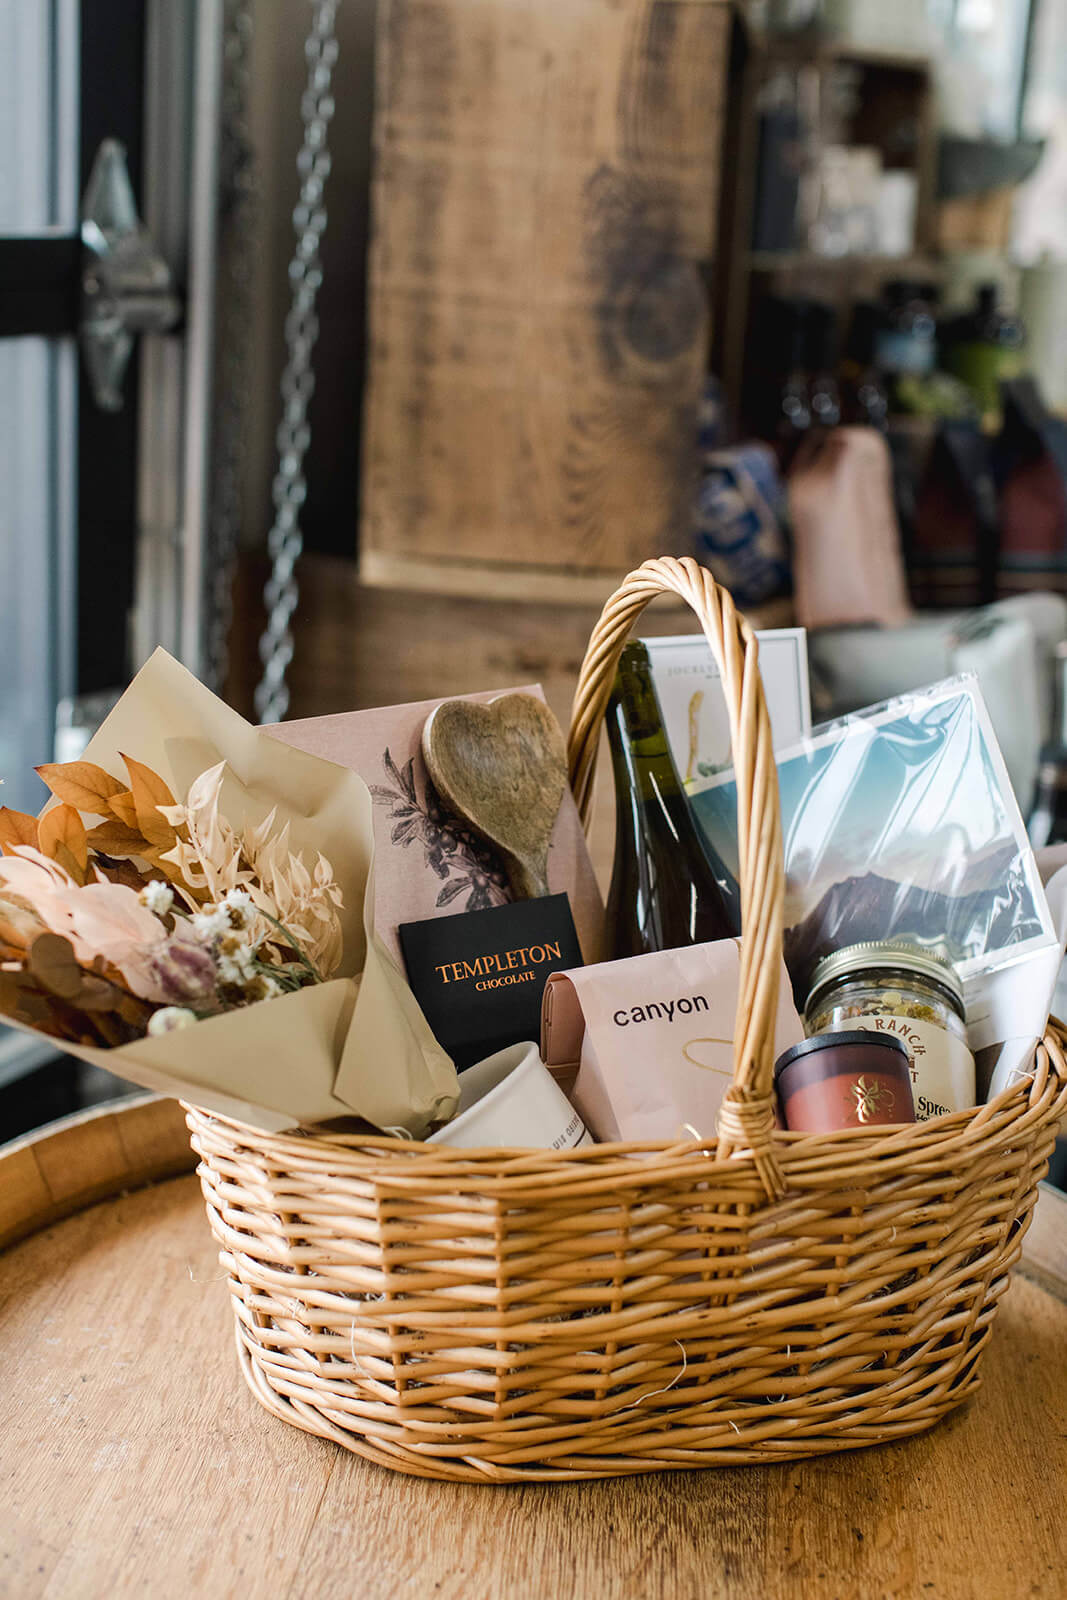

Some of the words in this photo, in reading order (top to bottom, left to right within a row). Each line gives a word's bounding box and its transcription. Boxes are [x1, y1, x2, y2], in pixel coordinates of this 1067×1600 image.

[435, 941, 561, 984] TEMPLETON
[475, 971, 536, 992] CHOCOLATE
[613, 995, 709, 1027] canyon
[874, 1018, 927, 1056] RANCH
